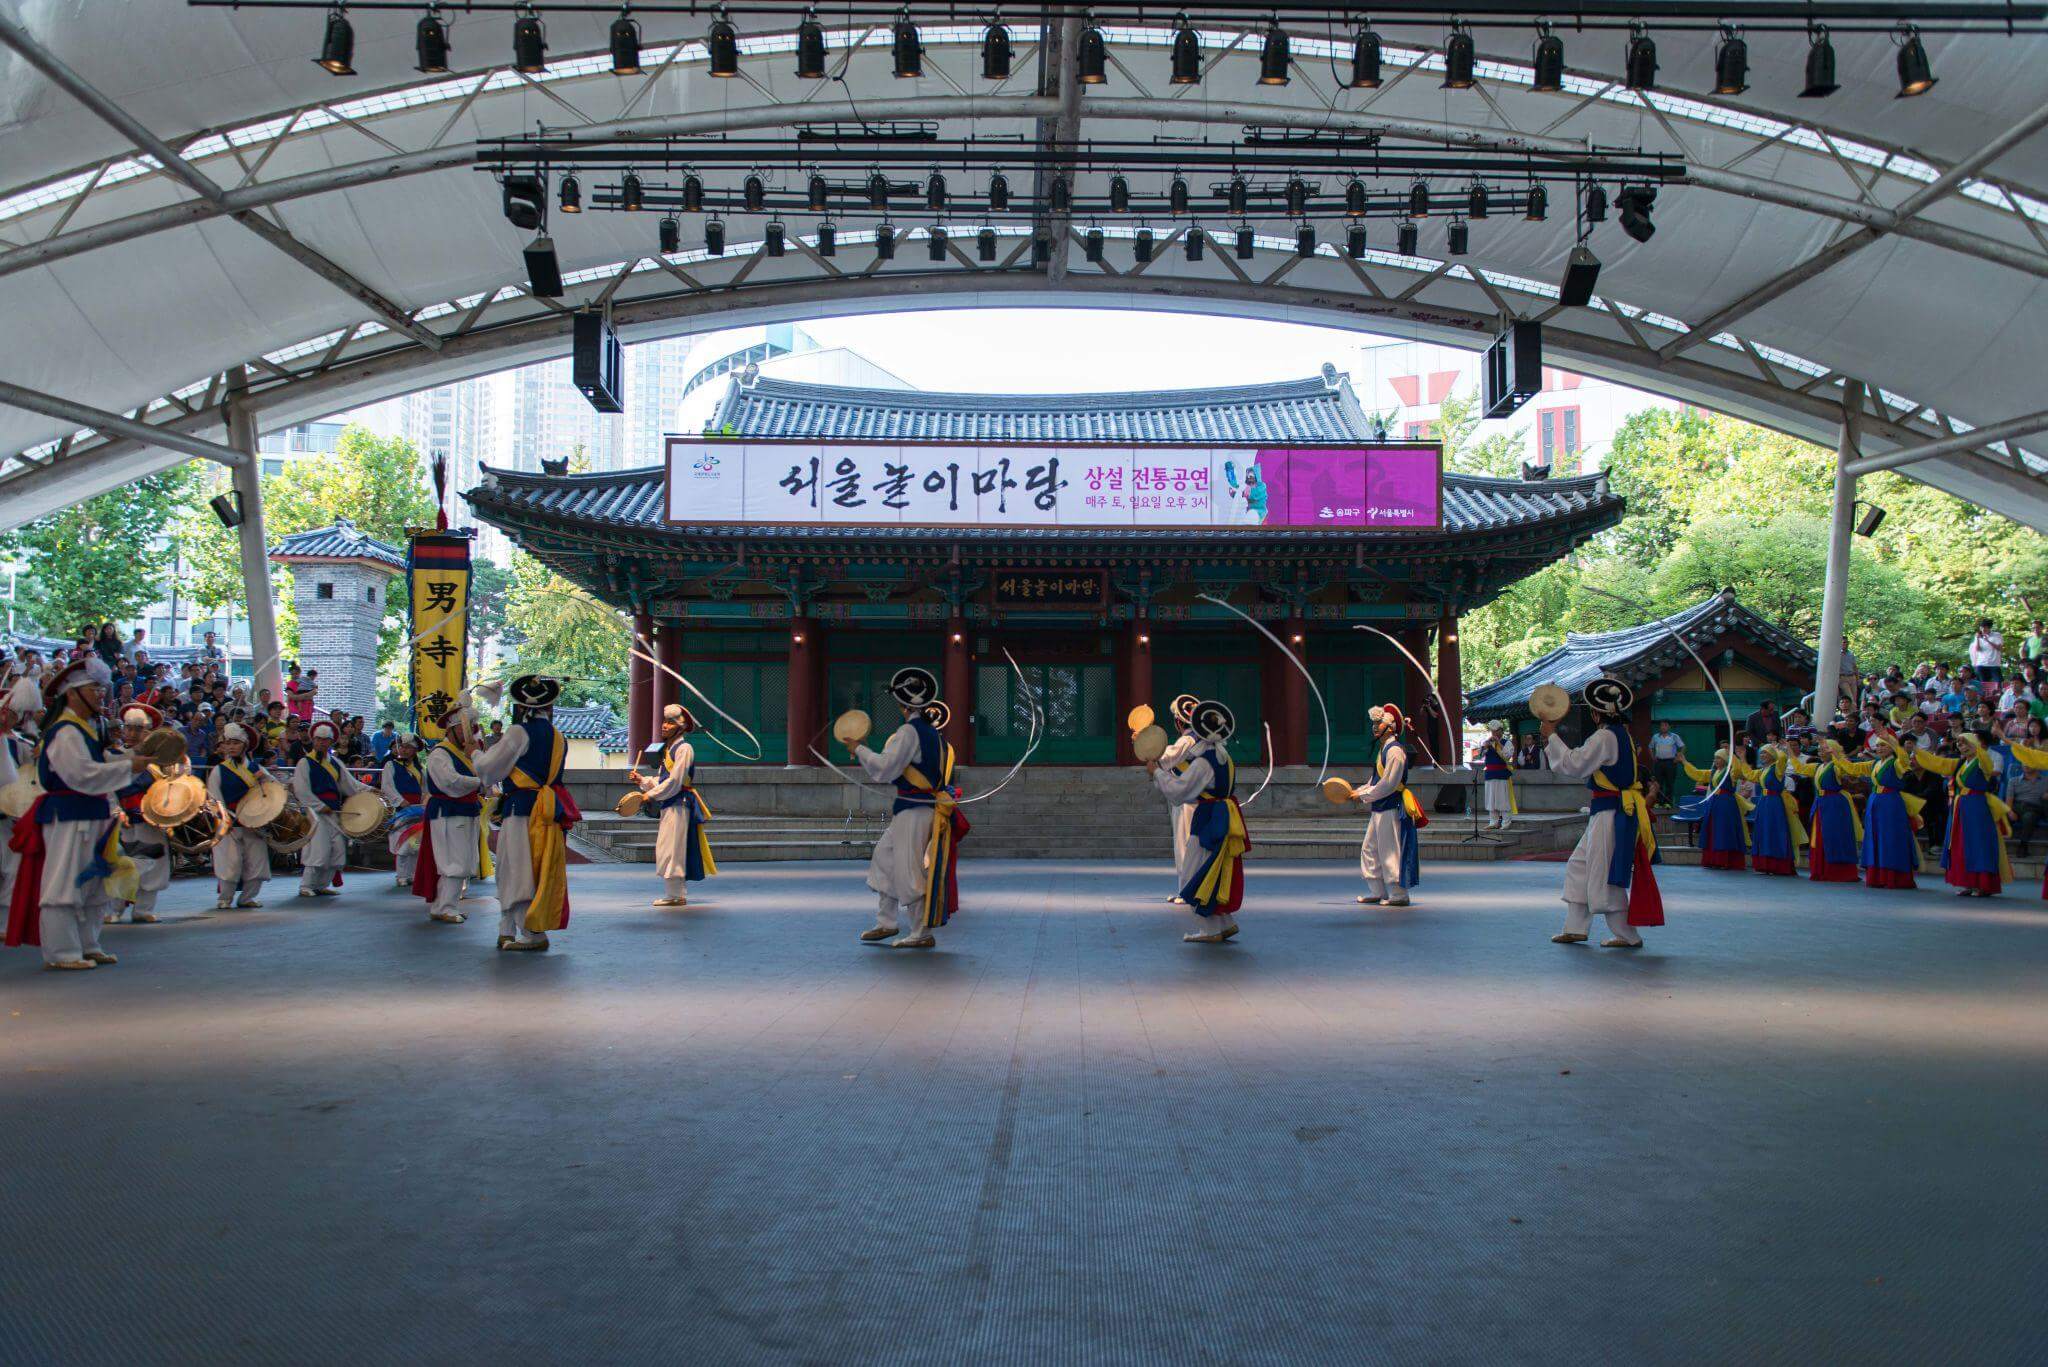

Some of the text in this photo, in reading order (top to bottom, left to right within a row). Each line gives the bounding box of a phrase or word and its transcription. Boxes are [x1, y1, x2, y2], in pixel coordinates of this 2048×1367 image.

[779, 456, 1068, 514] 서울놀이마당
[1084, 466, 1209, 493] 상설 전통공연
[1085, 495, 1208, 510] 매주 토, 일요일 오후 3시
[1379, 508, 1414, 519] 서울특별시
[1000, 578, 1097, 597] 서울놀이마당
